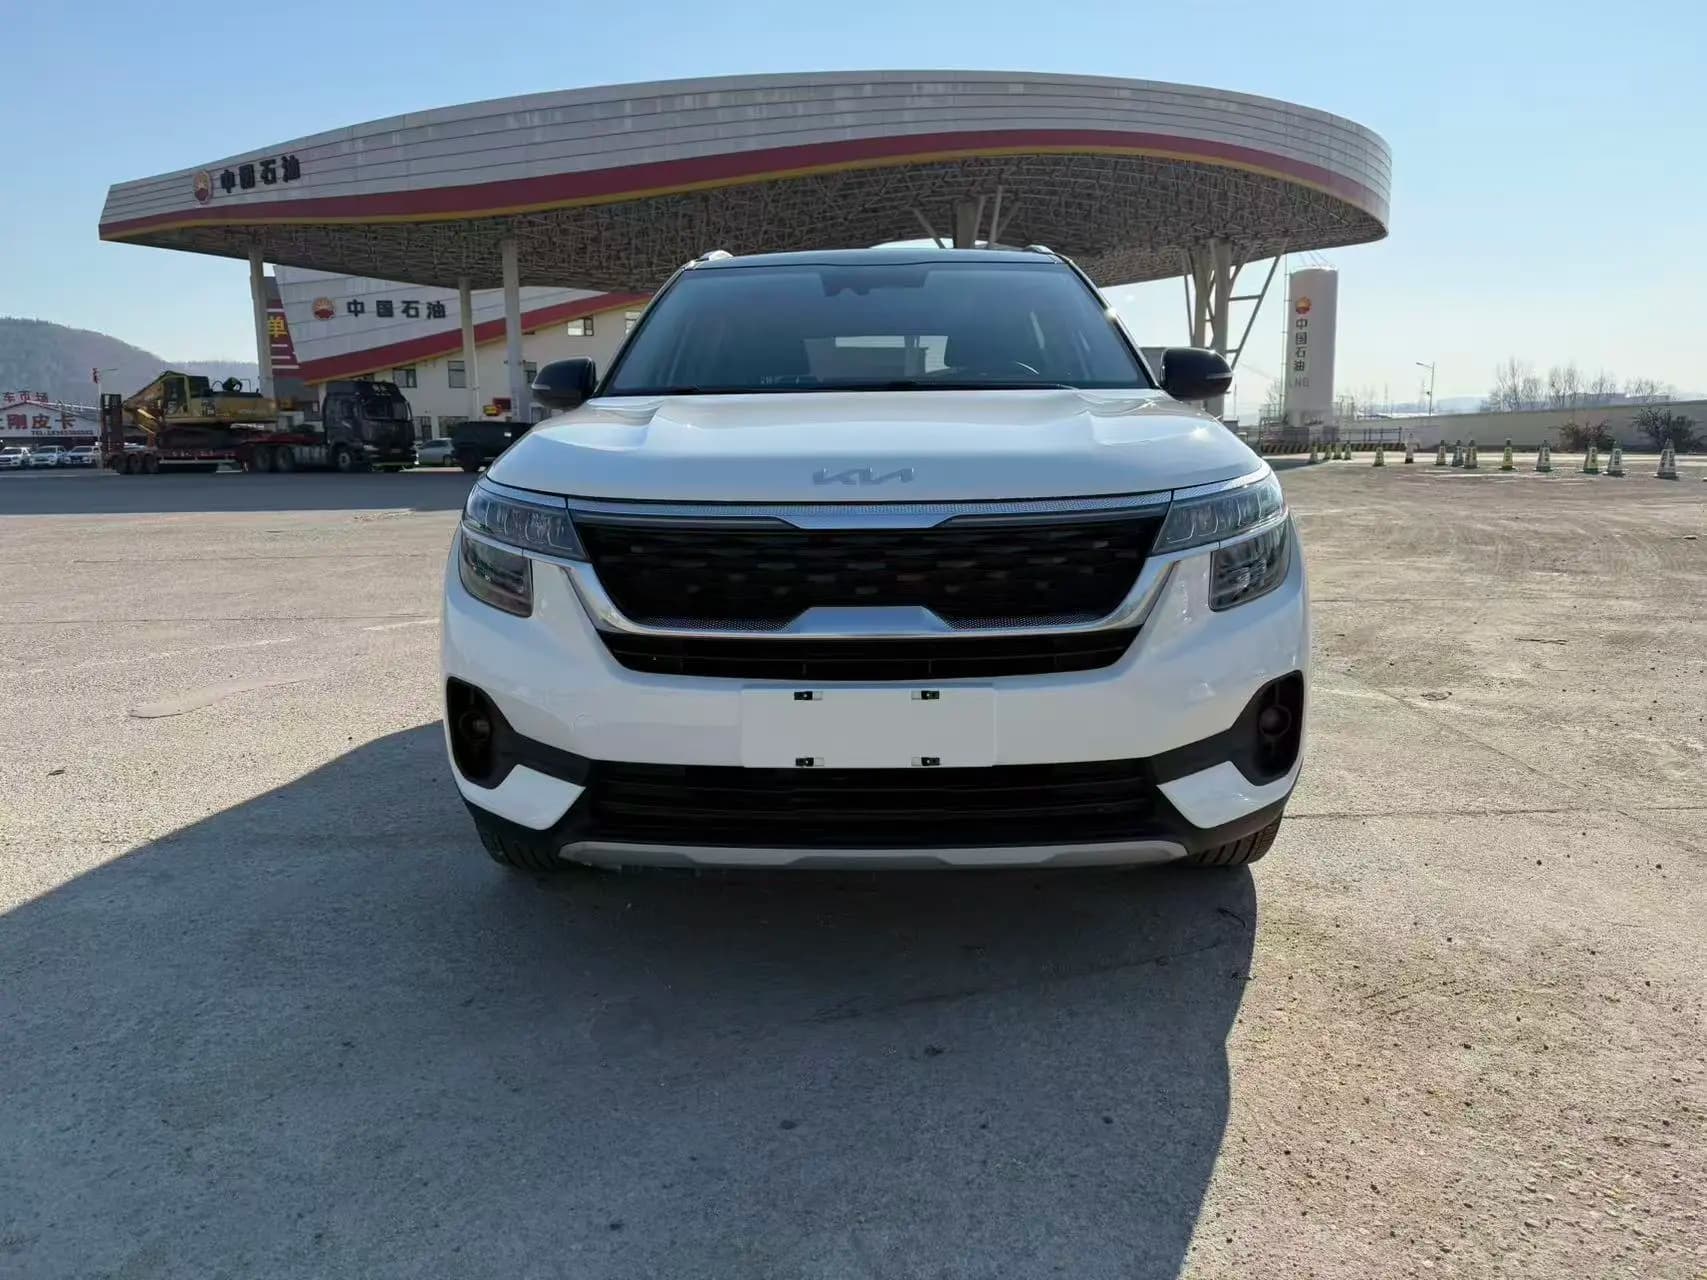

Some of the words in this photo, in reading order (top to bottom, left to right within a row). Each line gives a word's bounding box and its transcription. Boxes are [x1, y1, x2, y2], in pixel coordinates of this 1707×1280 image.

[220, 155, 300, 193] 中国石油
[346, 299, 447, 319] 中国石油
[1294, 318, 1307, 371] 中国石油
[0, 412, 77, 430] 刚皮卡
